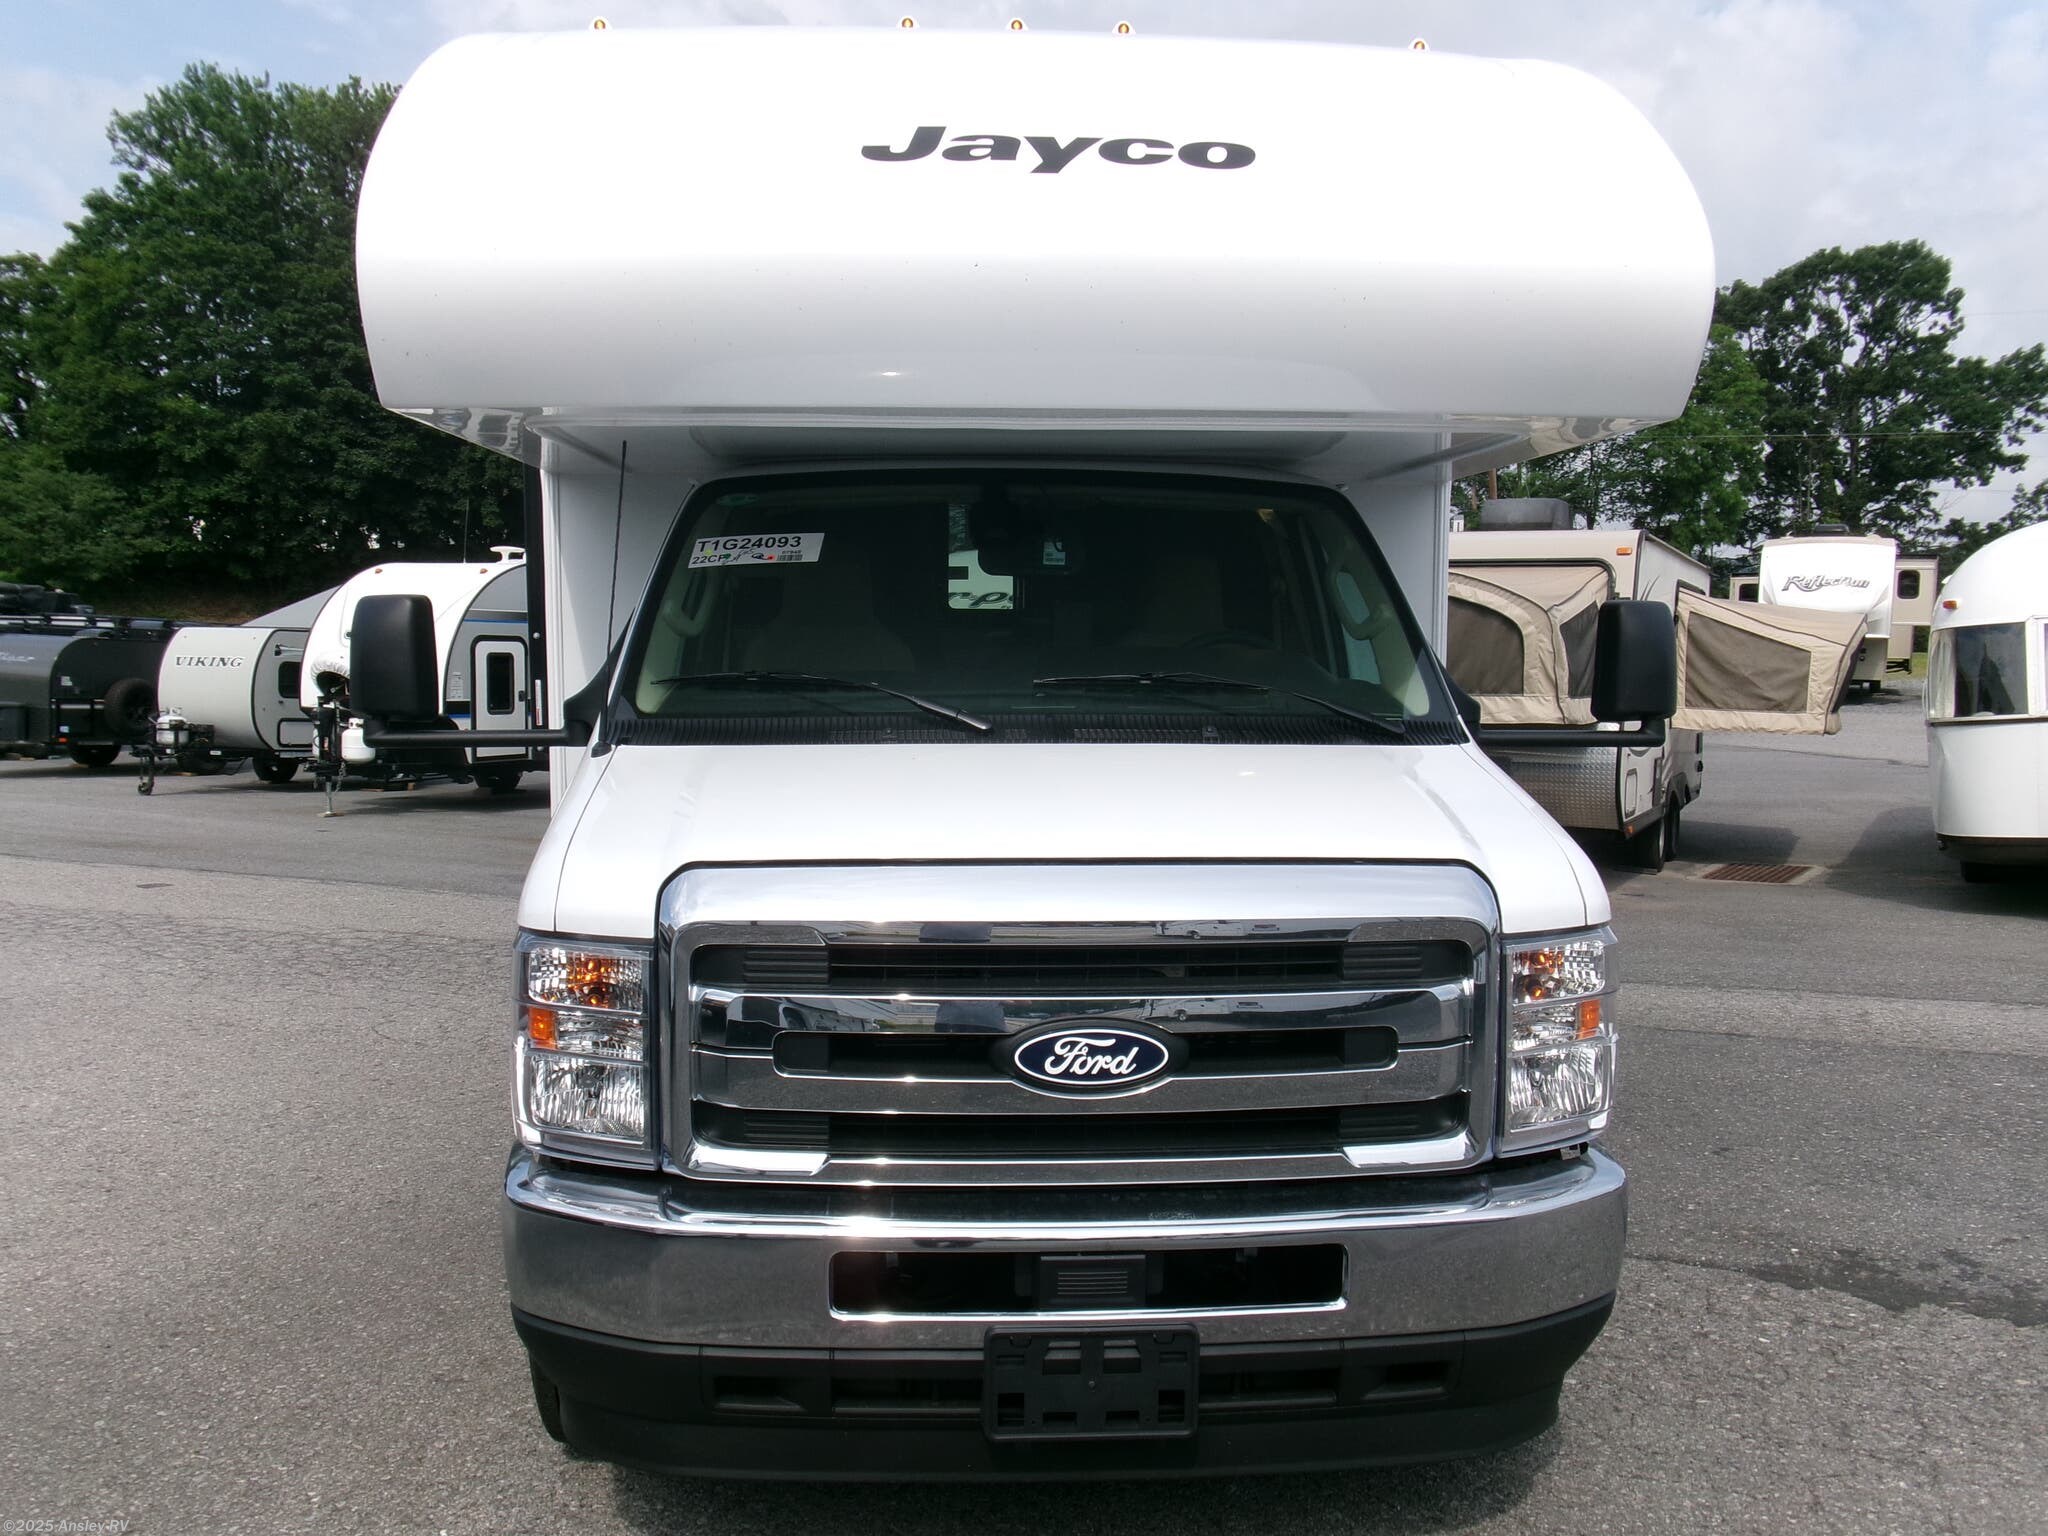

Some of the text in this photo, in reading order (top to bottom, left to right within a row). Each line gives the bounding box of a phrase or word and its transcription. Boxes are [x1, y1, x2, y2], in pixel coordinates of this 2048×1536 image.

[861, 126, 1256, 174] Jayco
[698, 537, 802, 552] T1G24093
[1781, 575, 1870, 592] Reflection
[176, 656, 243, 667] VIKING
[1044, 1036, 1139, 1076] Ford
